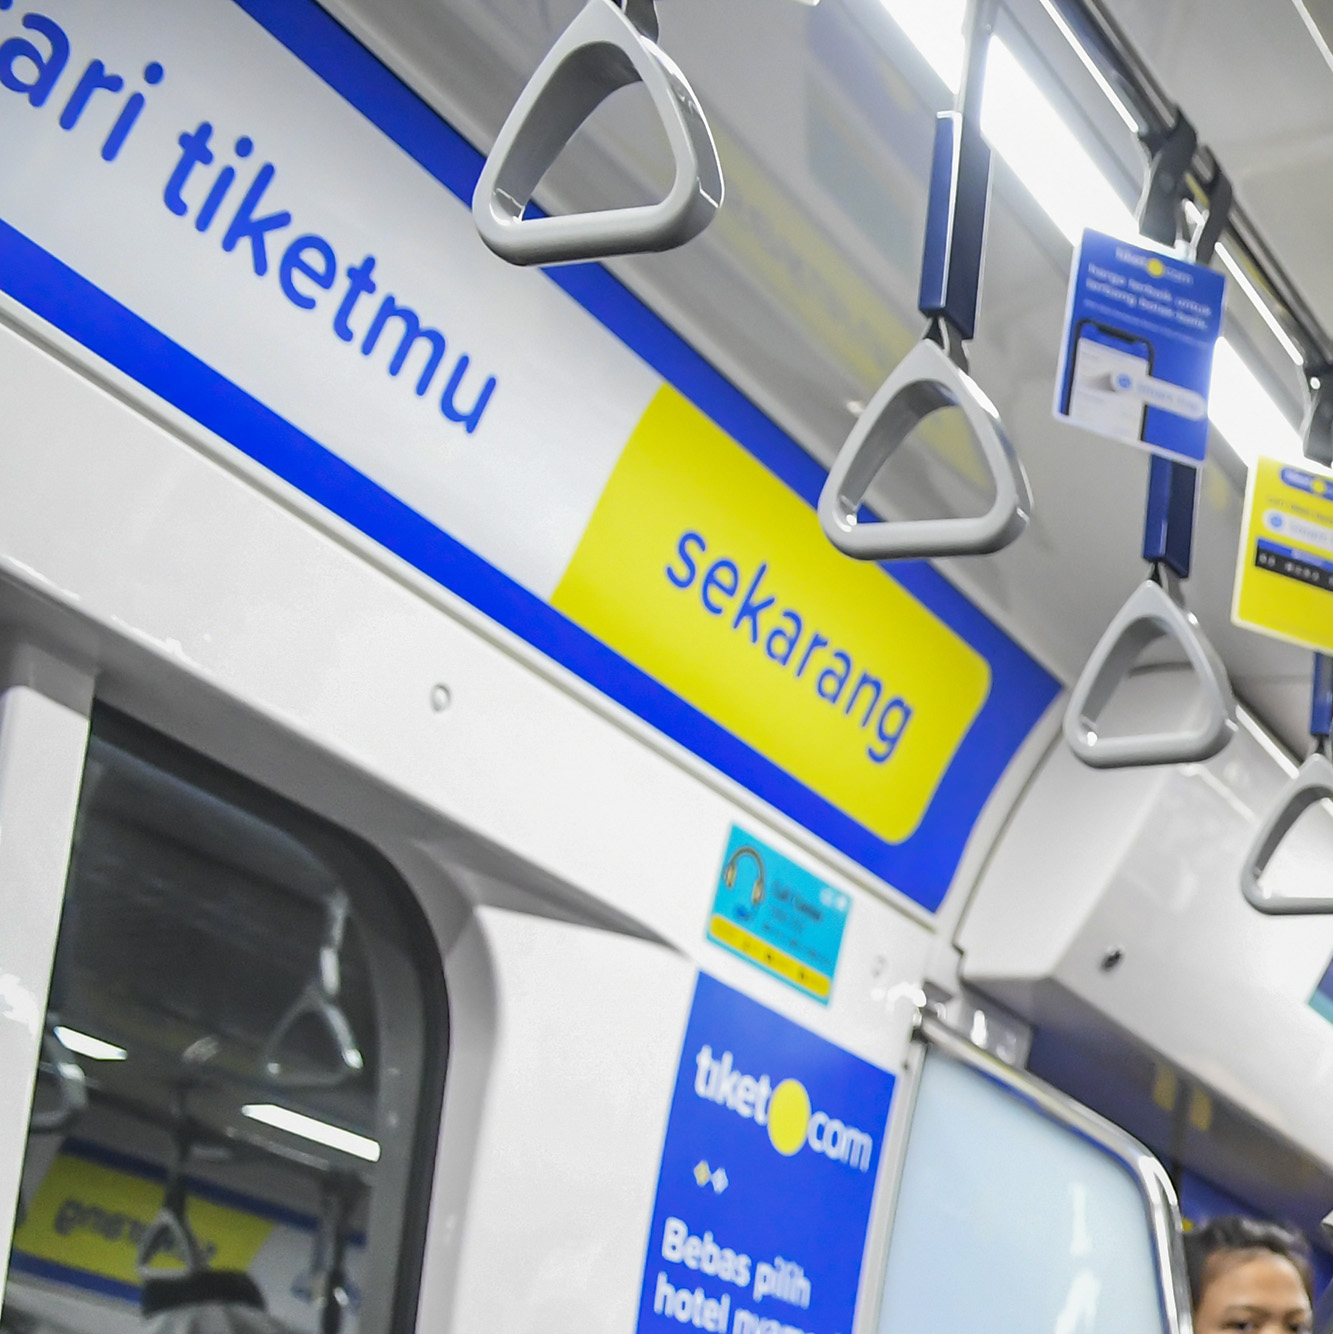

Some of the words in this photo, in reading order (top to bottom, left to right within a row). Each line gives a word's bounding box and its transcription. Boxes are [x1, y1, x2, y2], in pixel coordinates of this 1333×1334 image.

[0, 0, 164, 163] ari
[163, 120, 497, 435] tiketmu
[666, 529, 914, 765] sekarang
[661, 1216, 753, 1288] Bebas
[753, 1255, 812, 1310] pilih
